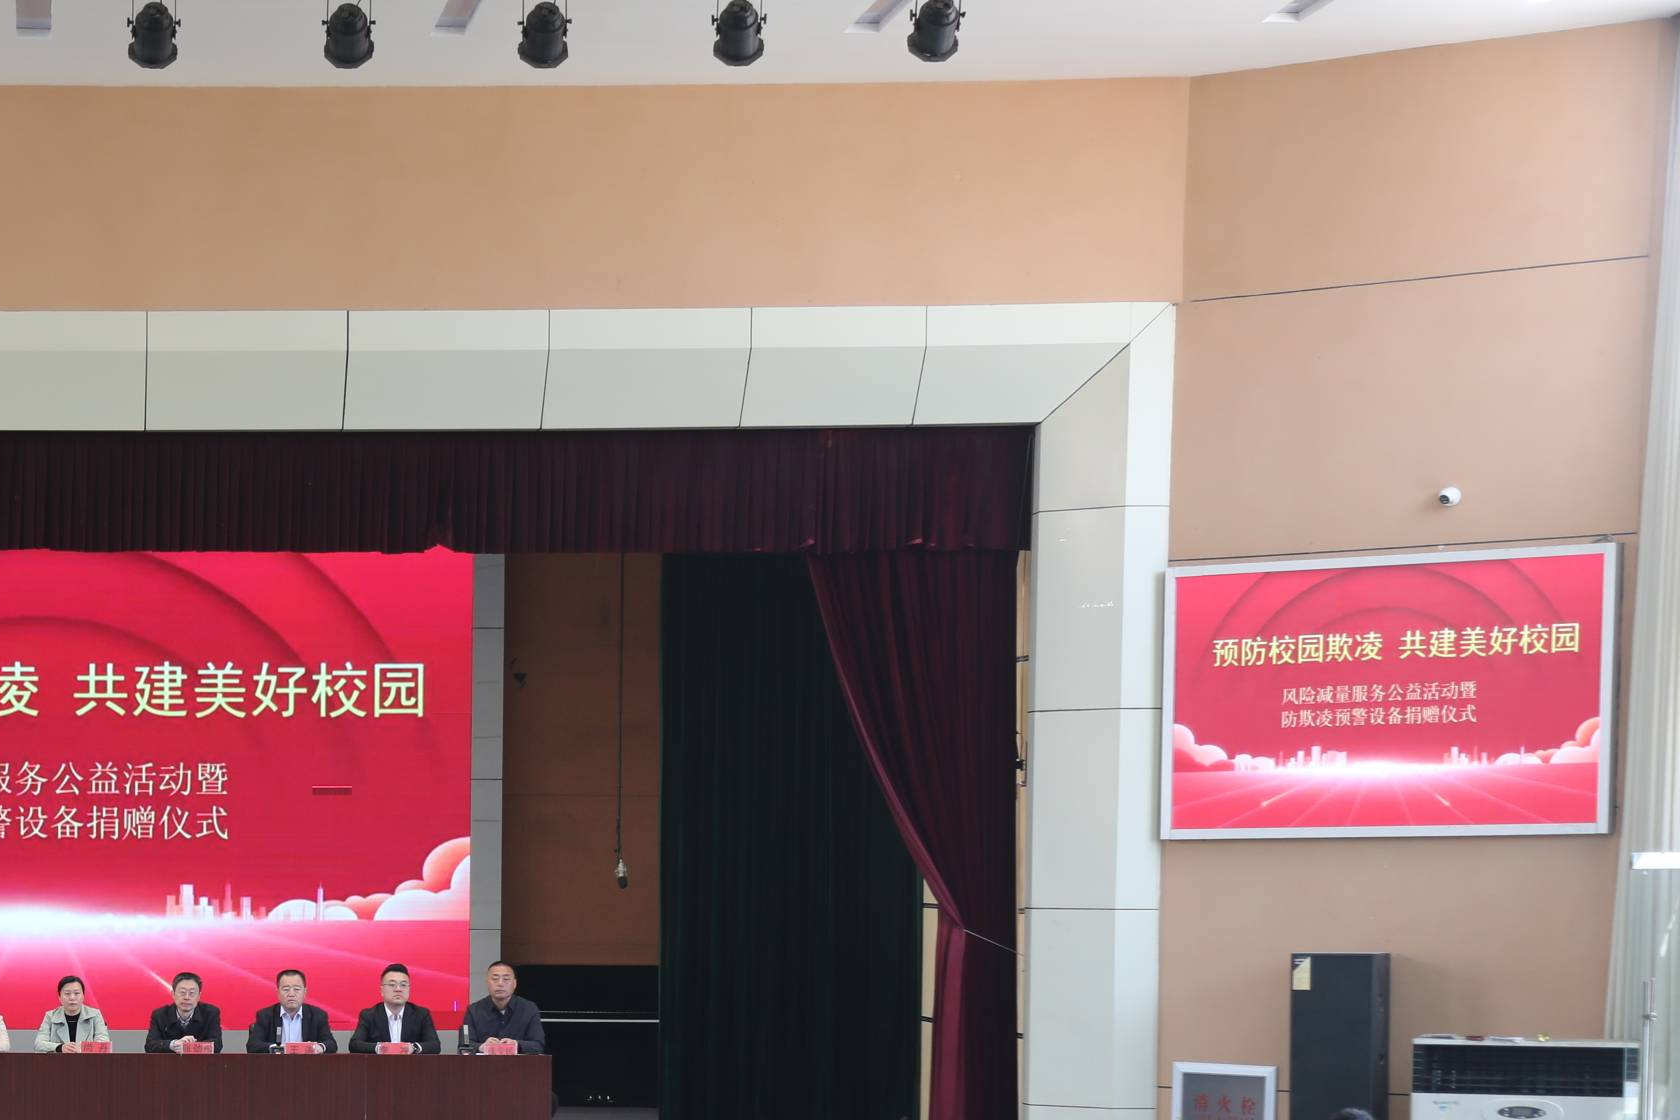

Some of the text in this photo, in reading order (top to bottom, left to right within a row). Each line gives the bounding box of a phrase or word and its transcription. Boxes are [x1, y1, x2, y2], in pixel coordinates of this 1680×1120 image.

[1212, 622, 1581, 668] 预防校园欺凌 共建美好校园
[73, 660, 425, 719] 共建美好校园
[1281, 680, 1478, 706] 风险减量服务公益活动暨
[1280, 704, 1478, 729] 防欺凌预警设备捐赠仪式
